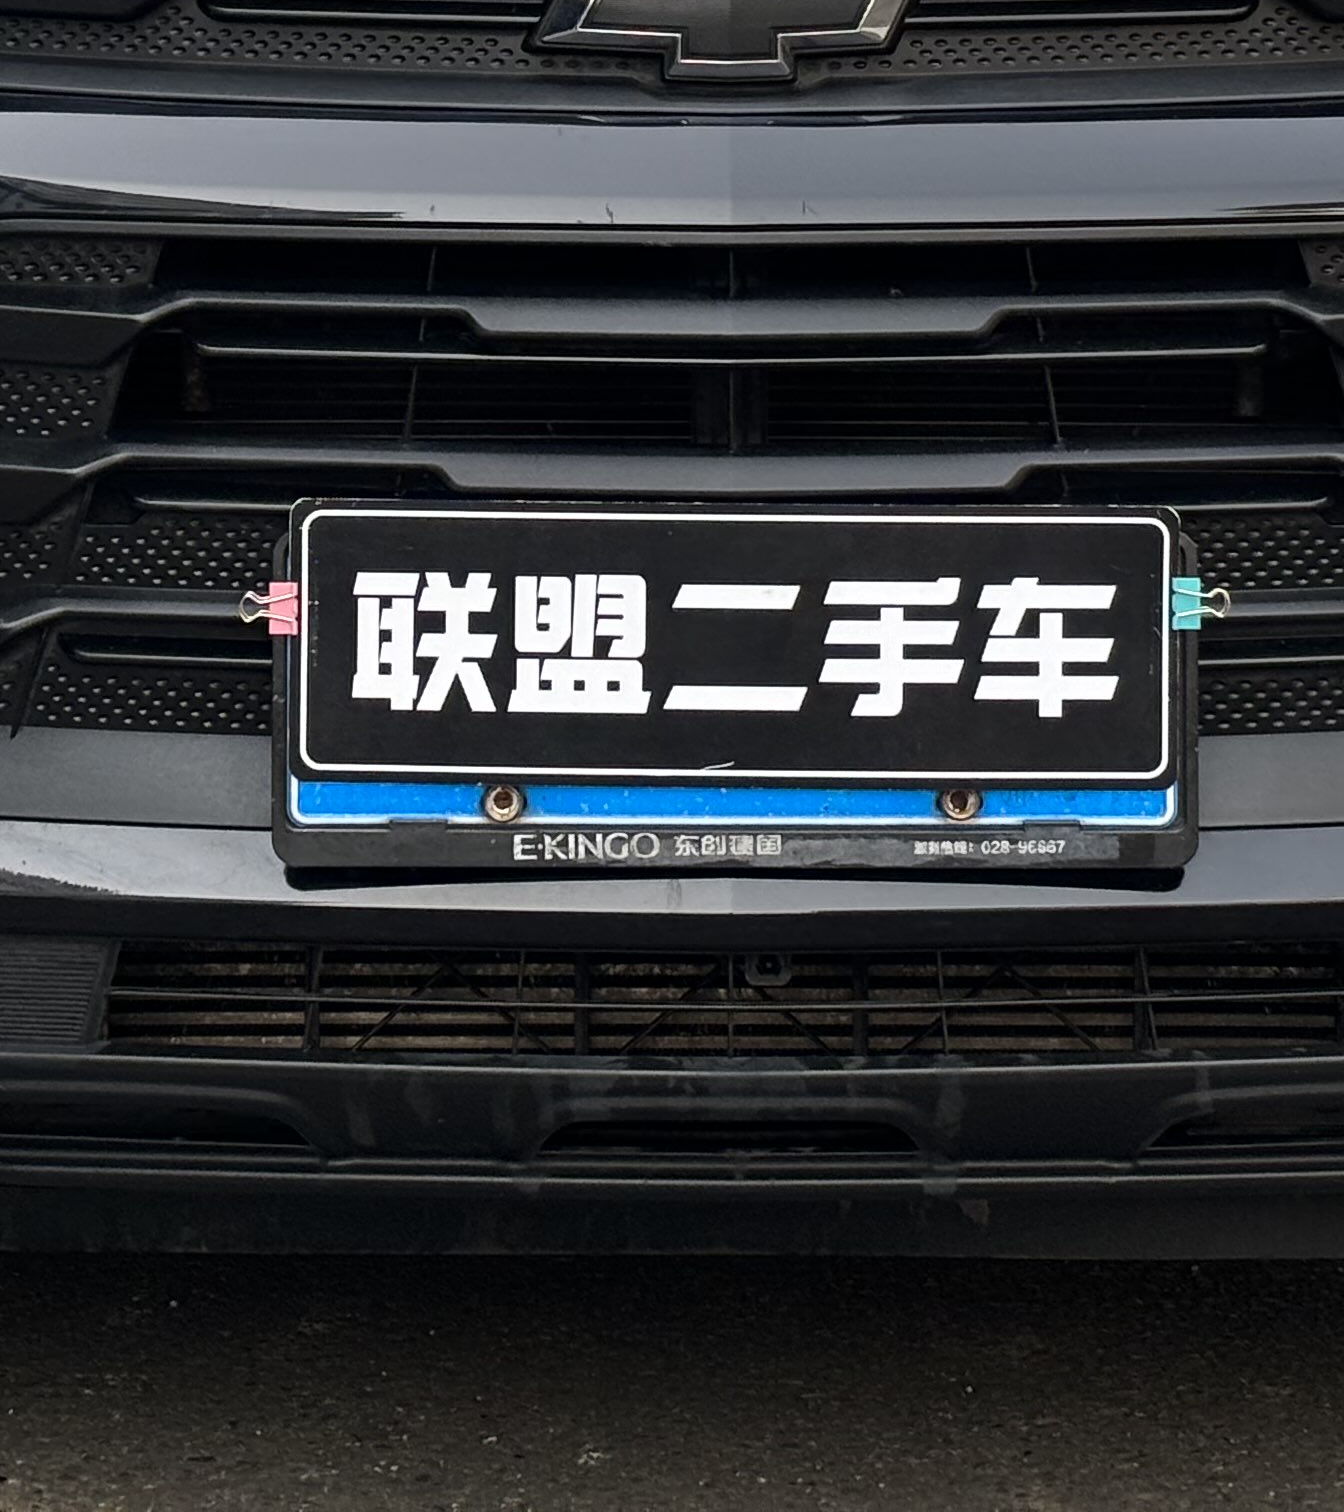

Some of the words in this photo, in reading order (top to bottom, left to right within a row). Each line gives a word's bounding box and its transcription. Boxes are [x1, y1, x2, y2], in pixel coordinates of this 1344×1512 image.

[351, 570, 1120, 718] 联盟二手车
